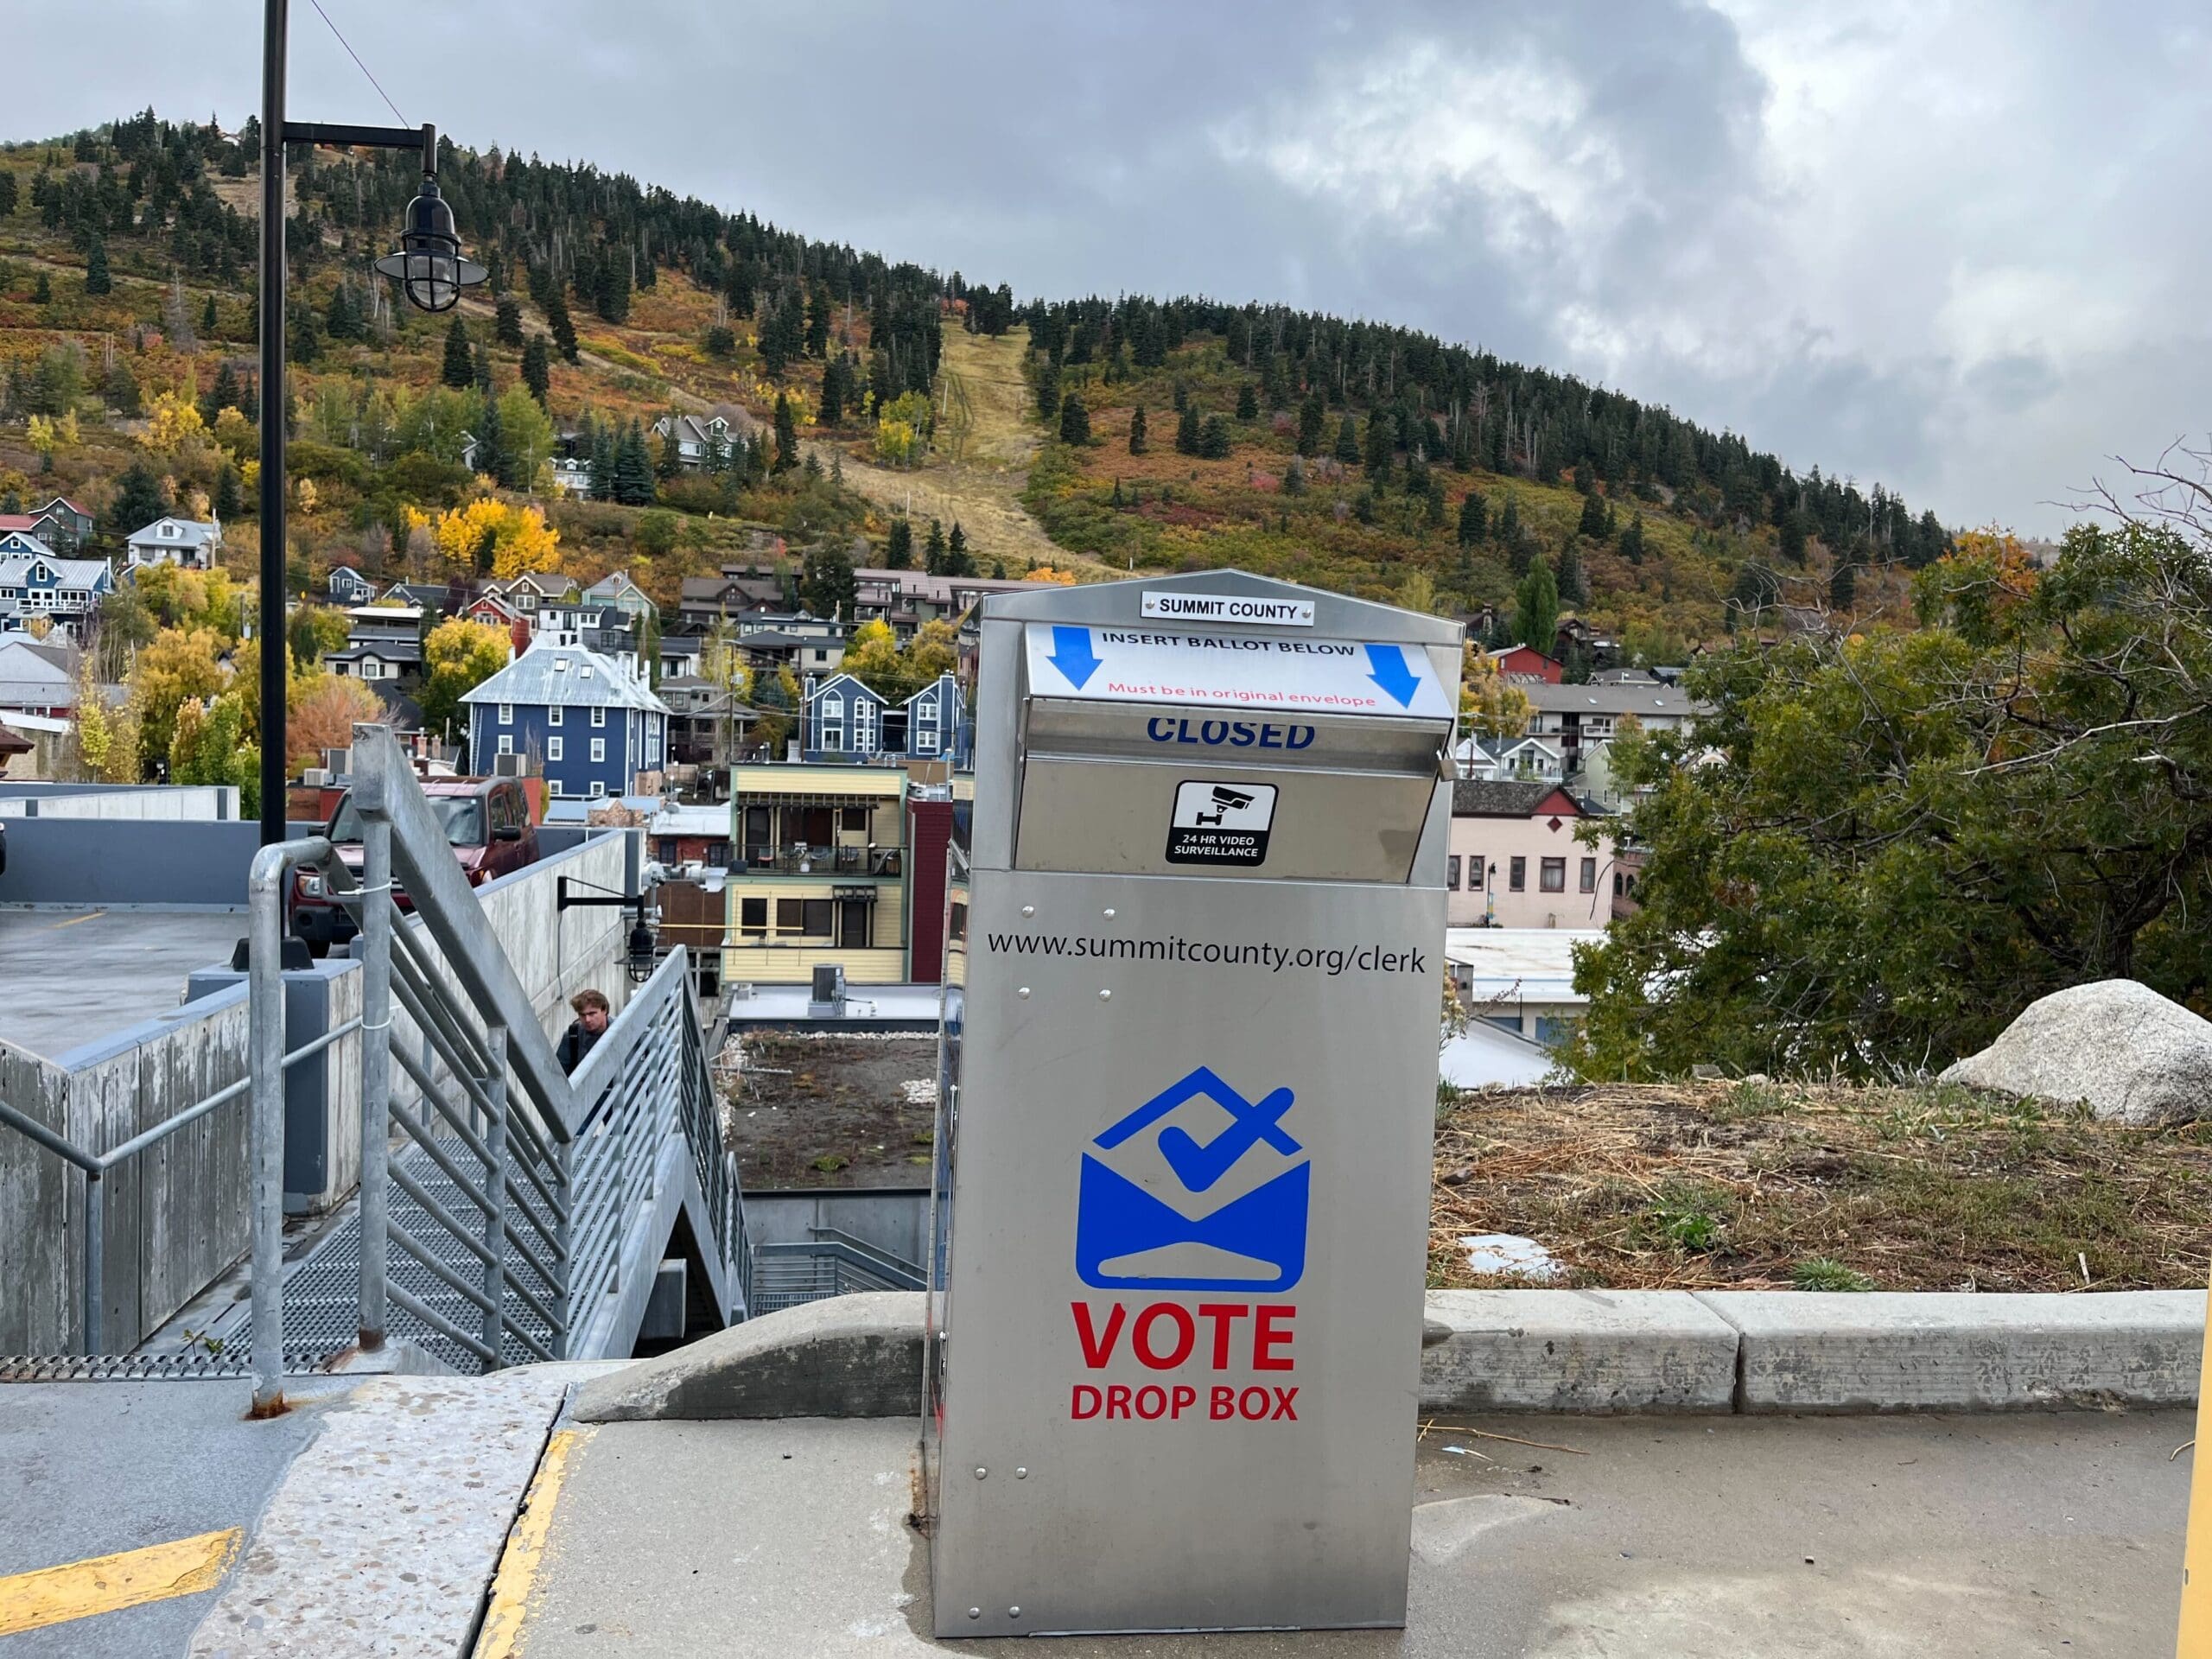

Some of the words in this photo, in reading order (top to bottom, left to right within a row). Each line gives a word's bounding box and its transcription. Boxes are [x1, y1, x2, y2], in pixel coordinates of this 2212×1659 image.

[1160, 598, 1224, 614] SUMMIT
[1230, 602, 1298, 619] COUNTY
[1103, 632, 1181, 645] INSERT
[1188, 638, 1271, 651] BALLOT
[1278, 643, 1355, 656] BELOW
[1109, 683, 1157, 694] Must
[1161, 686, 1185, 696] be
[1191, 687, 1206, 697] in
[1213, 690, 1283, 702] original
[1289, 694, 1376, 707] envelope
[1147, 717, 1315, 749] CLOSED
[1174, 845, 1259, 857] SURVEILLANCE
[1182, 834, 1198, 843] 24
[1200, 835, 1217, 844] HR
[1219, 836, 1255, 846] VIDEO
[987, 931, 1427, 976] www.summitcounty.org/clerk
[1071, 1301, 1296, 1370] VOTE
[1071, 1385, 1196, 1420] DROP
[1210, 1386, 1300, 1421] BOX
